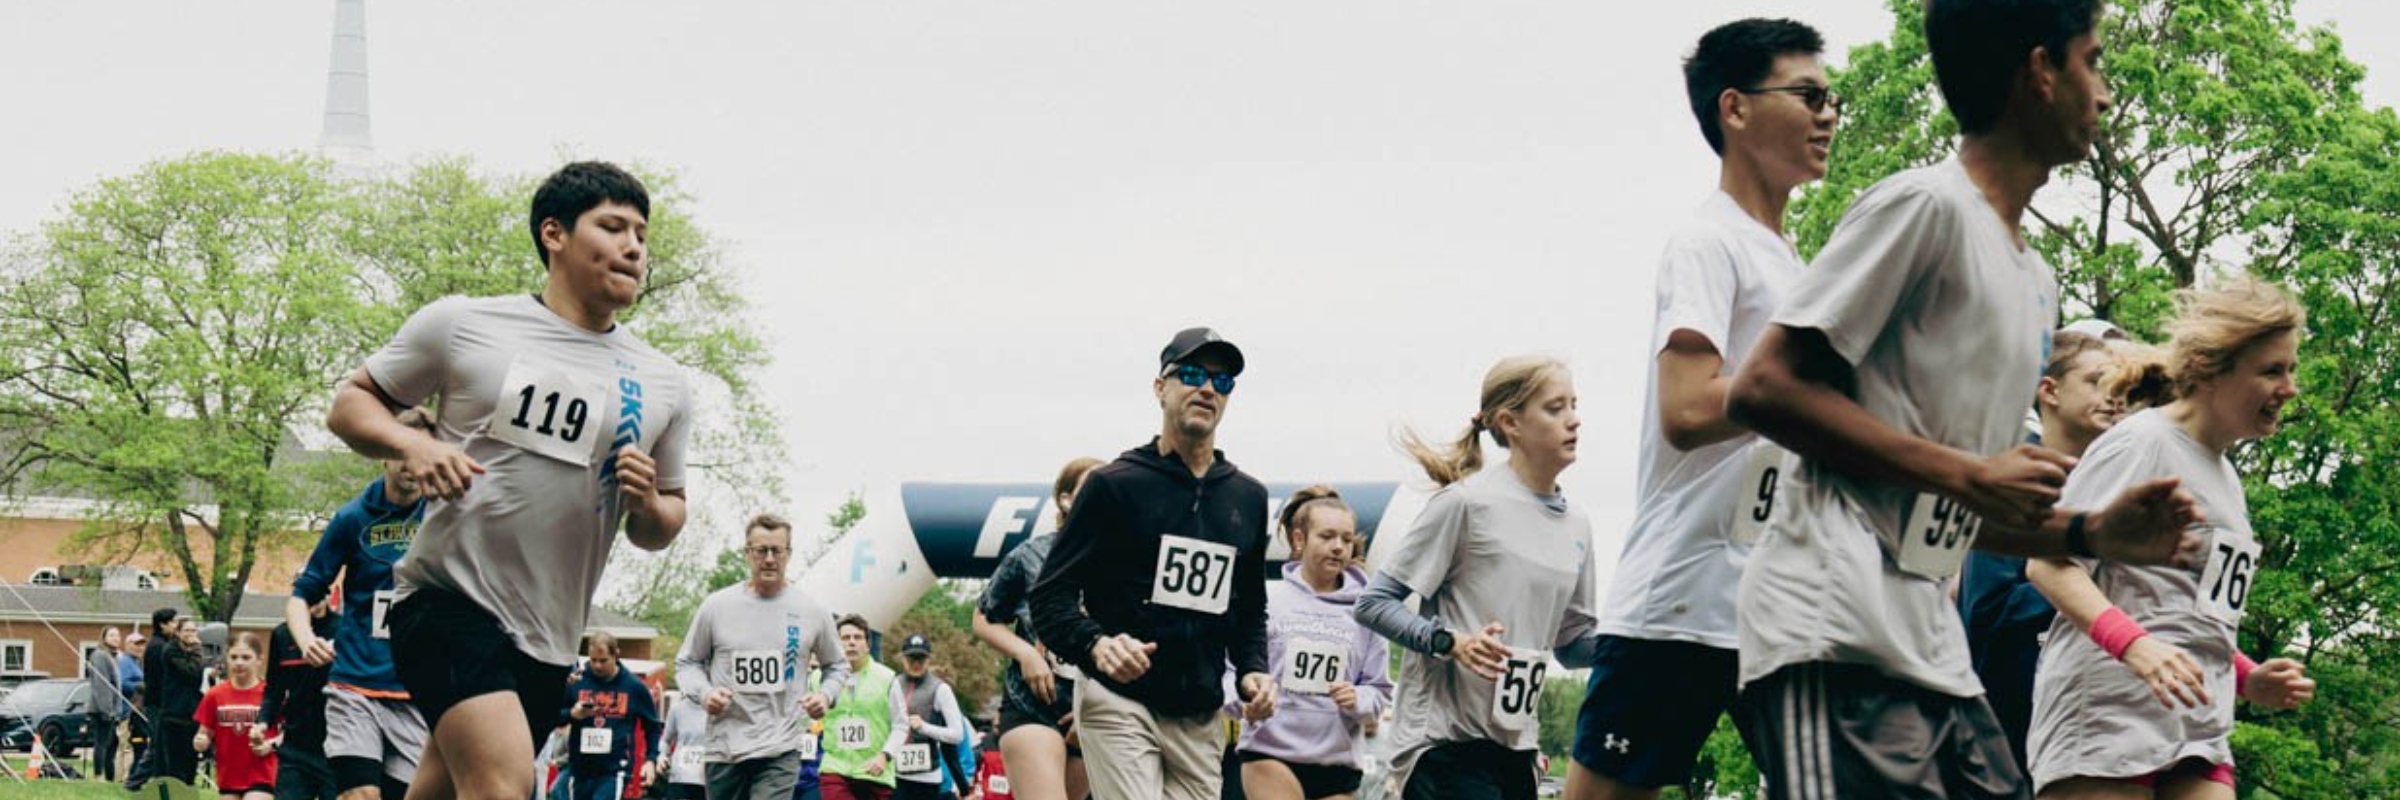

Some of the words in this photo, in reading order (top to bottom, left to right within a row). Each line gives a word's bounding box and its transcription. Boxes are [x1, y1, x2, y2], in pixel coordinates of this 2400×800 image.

[511, 384, 588, 443] 119
[1753, 466, 1778, 523] 9
[1162, 546, 1230, 600] 587
[2210, 543, 2259, 610] 76
[735, 656, 779, 684] 580
[1294, 651, 1339, 682] 976
[841, 726, 865, 742] 120
[902, 749, 925, 766] 379
